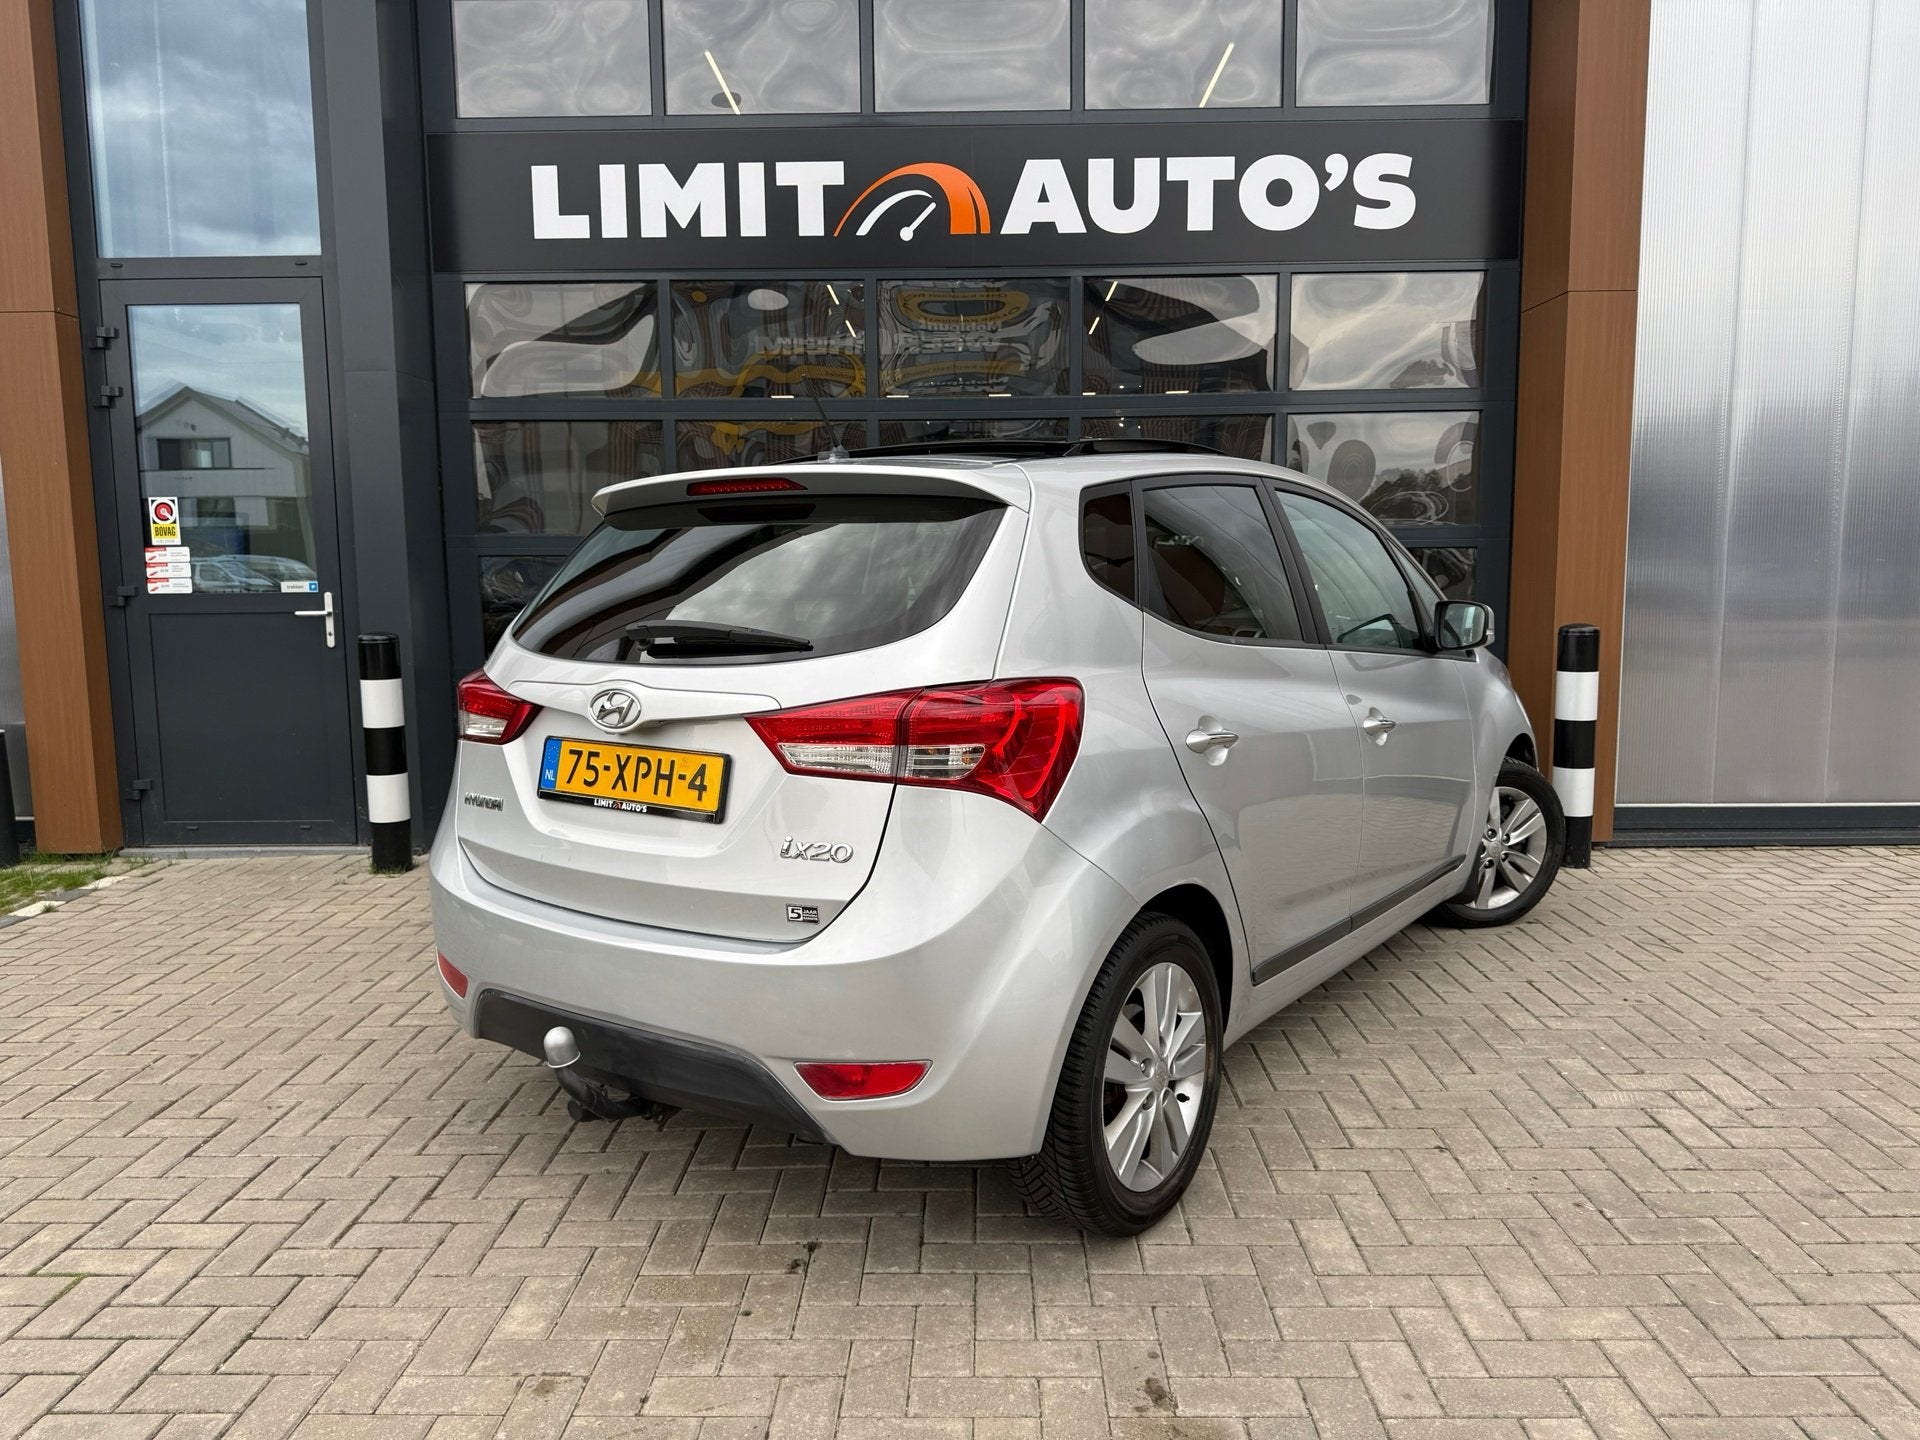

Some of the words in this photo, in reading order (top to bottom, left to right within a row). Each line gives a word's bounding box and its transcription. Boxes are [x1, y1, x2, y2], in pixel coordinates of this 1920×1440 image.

[531, 160, 845, 239] LIMIT
[1000, 154, 1417, 235] AUTO'S
[154, 526, 176, 537] BOVAG
[544, 769, 556, 781] NL
[566, 749, 707, 801] 75-XPH-4
[593, 798, 614, 808] LIMIT
[621, 802, 648, 813] AUTO'S
[790, 907, 802, 920] 5
